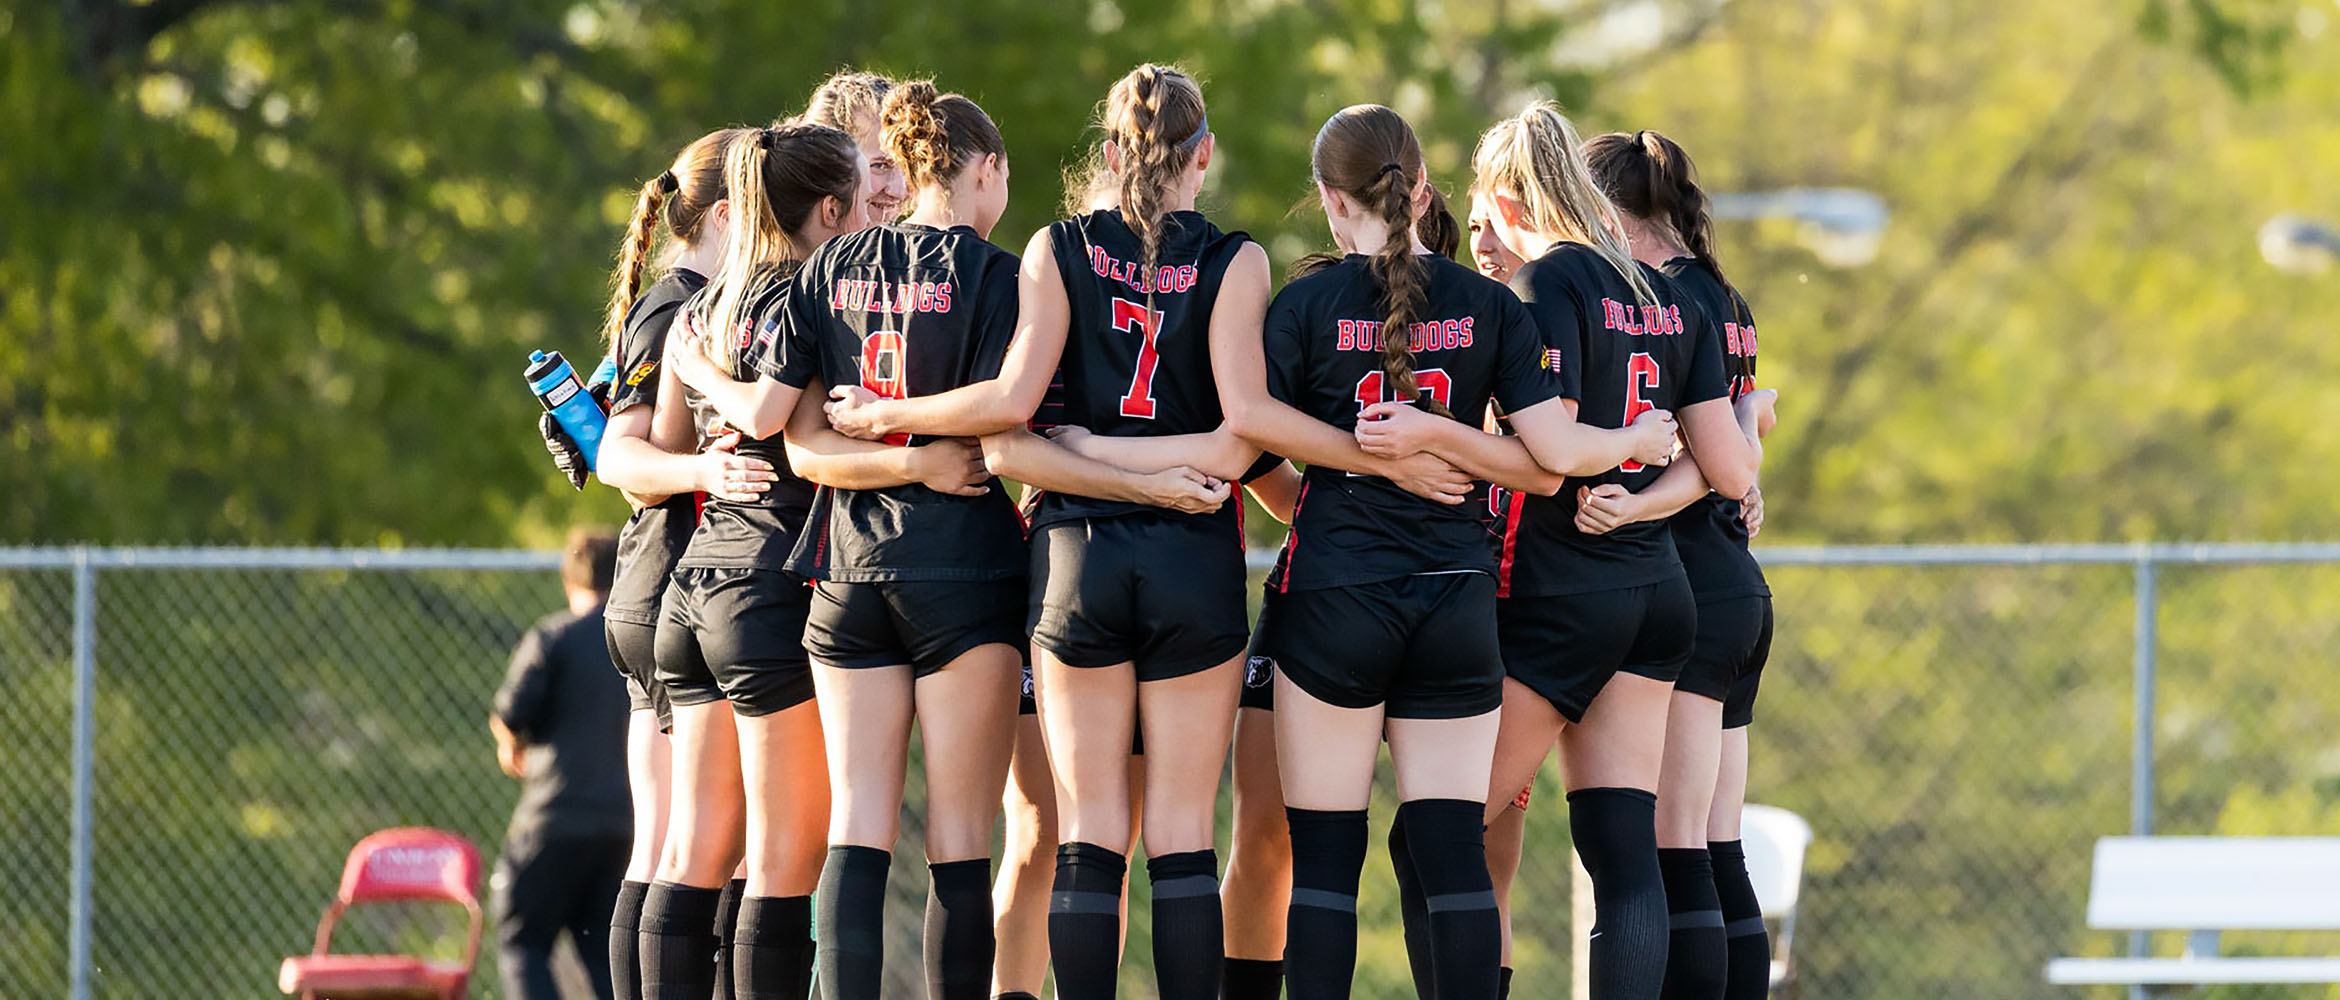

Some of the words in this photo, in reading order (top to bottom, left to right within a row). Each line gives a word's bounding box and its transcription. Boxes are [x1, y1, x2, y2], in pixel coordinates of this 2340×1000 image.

[1111, 296, 1165, 419] 7
[1336, 316, 1475, 352] BULDOGS
[1620, 352, 1660, 473] 6
